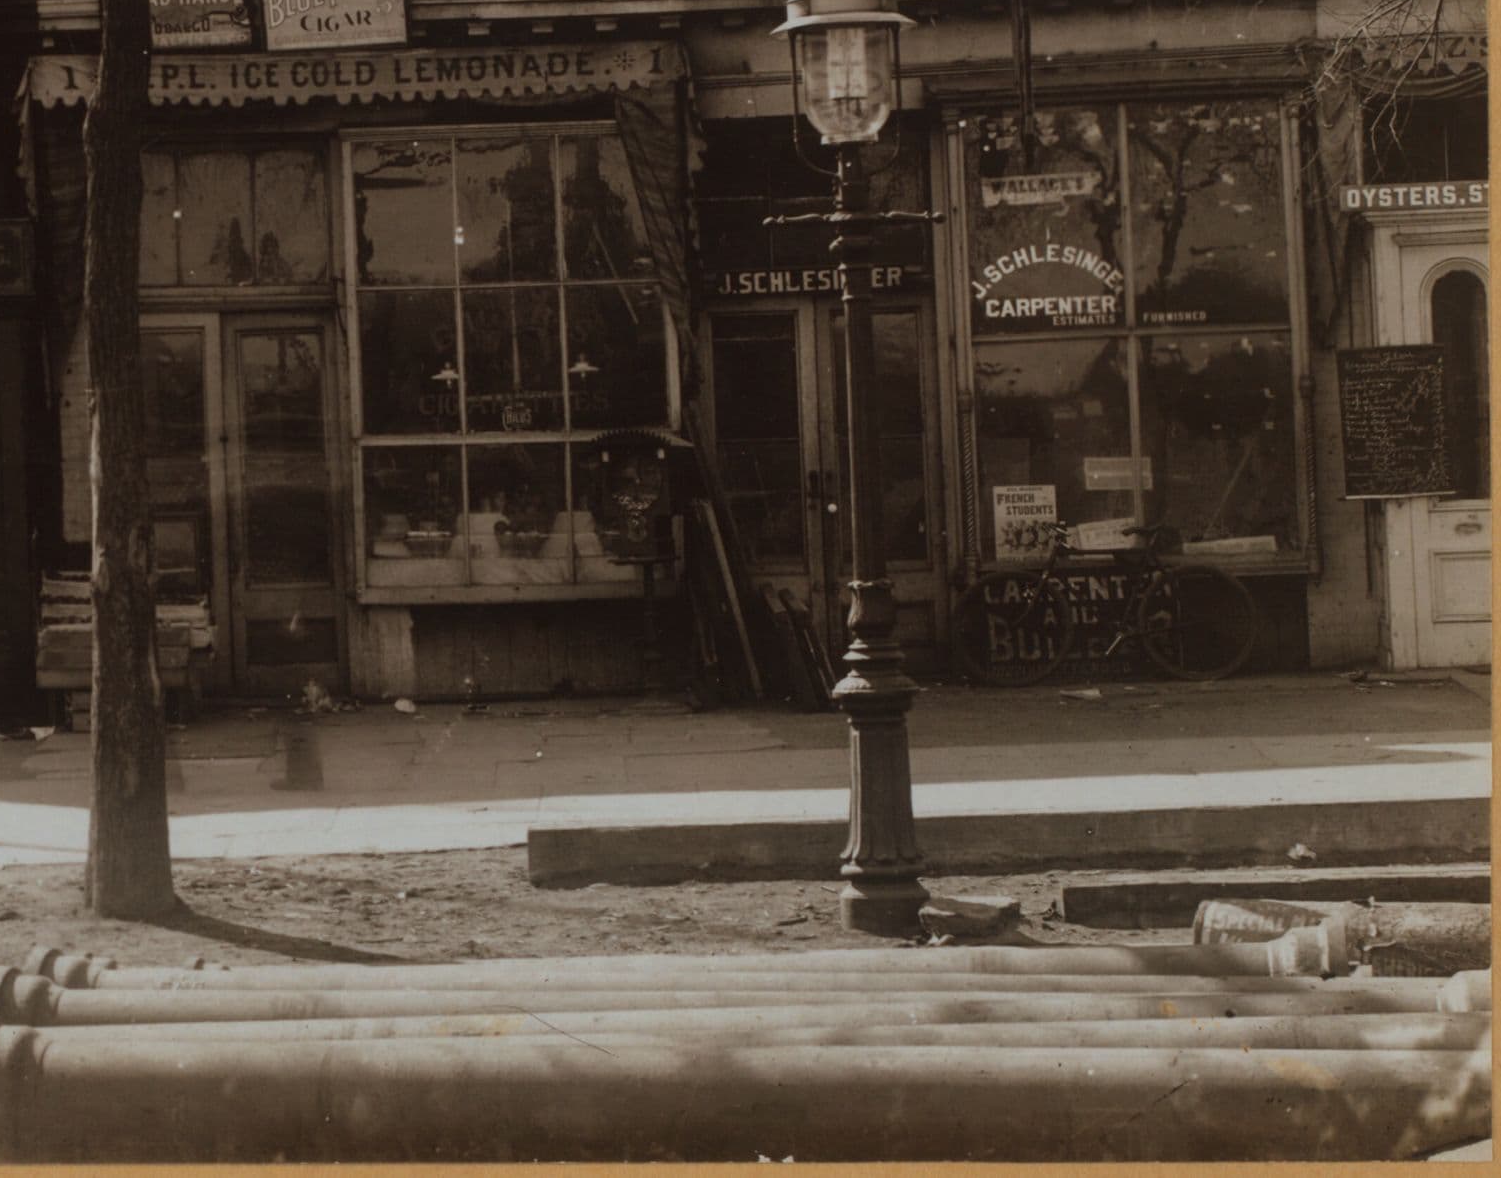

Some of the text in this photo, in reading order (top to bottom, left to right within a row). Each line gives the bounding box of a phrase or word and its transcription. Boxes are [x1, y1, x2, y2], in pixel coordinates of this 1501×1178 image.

[300, 9, 373, 32] CIGAR
[231, 61, 279, 89] ICE
[290, 60, 377, 89] COLD
[395, 51, 613, 84] LEMONADE.
[985, 294, 1117, 318] CARPENTER
[1052, 310, 1207, 327] ESTIMATES FURNISHED
[996, 493, 1035, 505] FRENCH
[1006, 504, 1054, 516] STUDENTS
